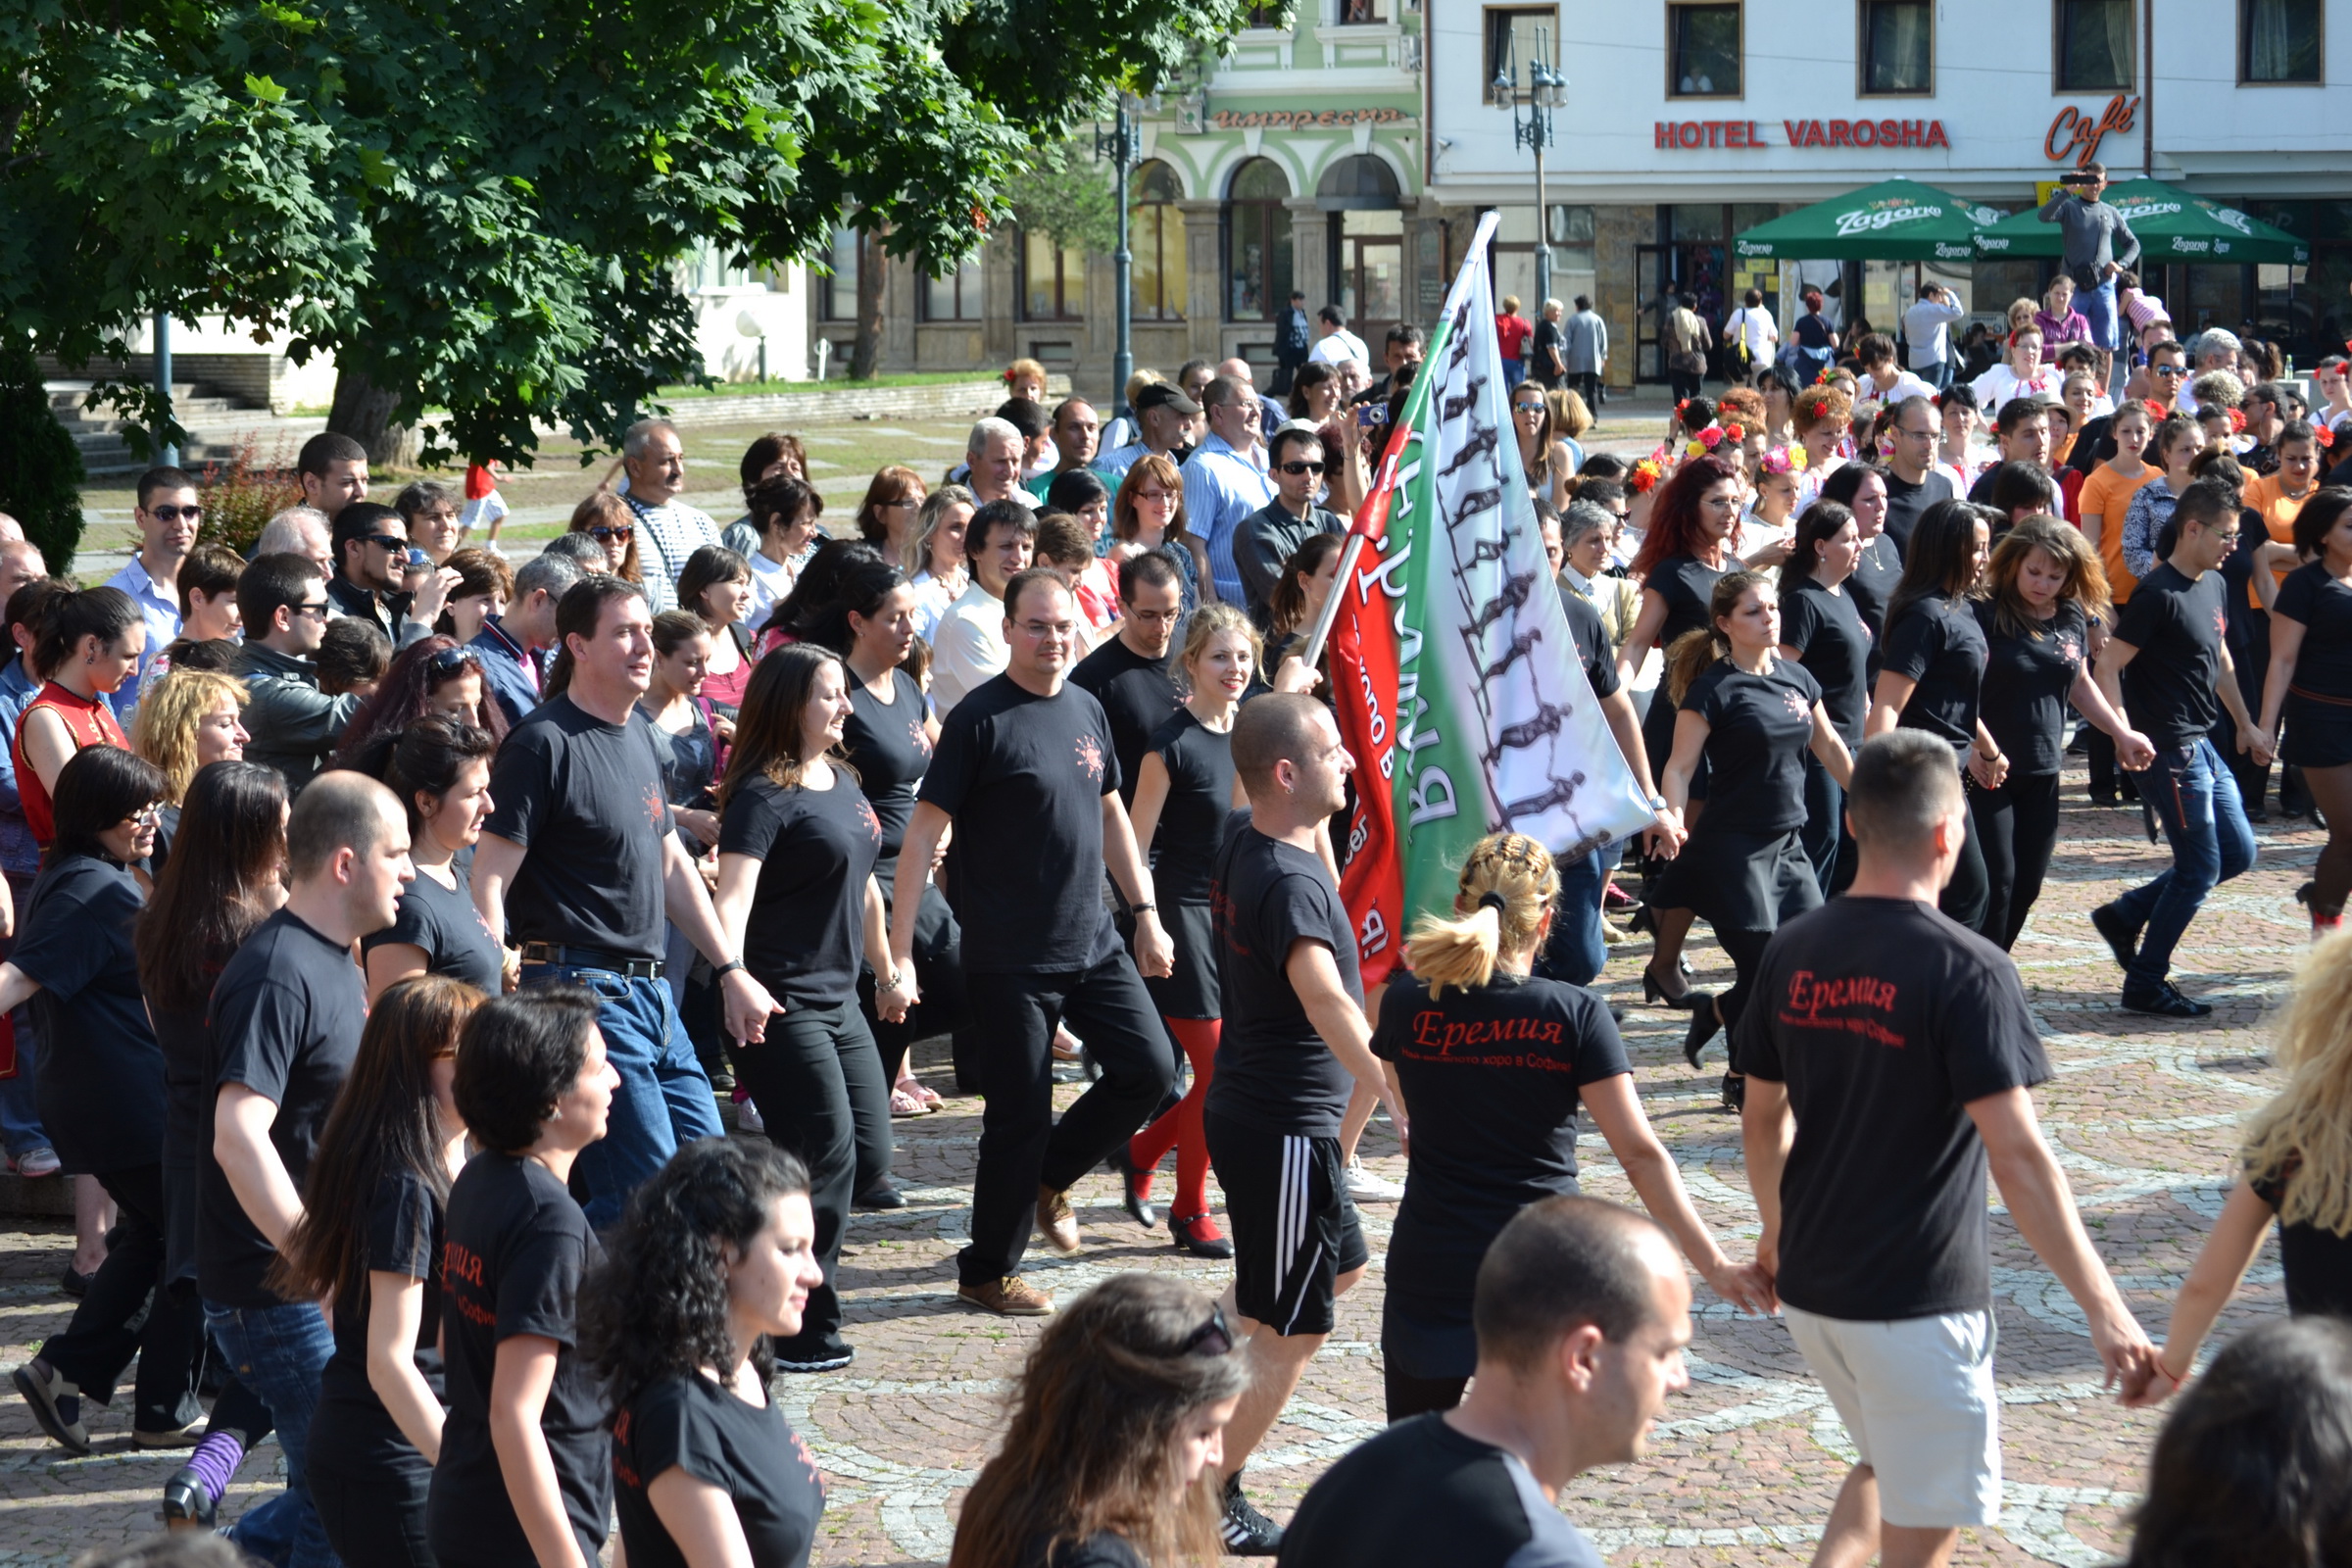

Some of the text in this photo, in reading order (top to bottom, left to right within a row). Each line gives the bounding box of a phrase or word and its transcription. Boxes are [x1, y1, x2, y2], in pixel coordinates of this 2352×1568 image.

[1654, 119, 1950, 149] HOTEL VAROSHA
[2044, 94, 2140, 169] Café
[1836, 205, 1941, 236] Zagorka
[1412, 1010, 1563, 1055] Еремия
[1482, 1054, 1512, 1068] хоро
